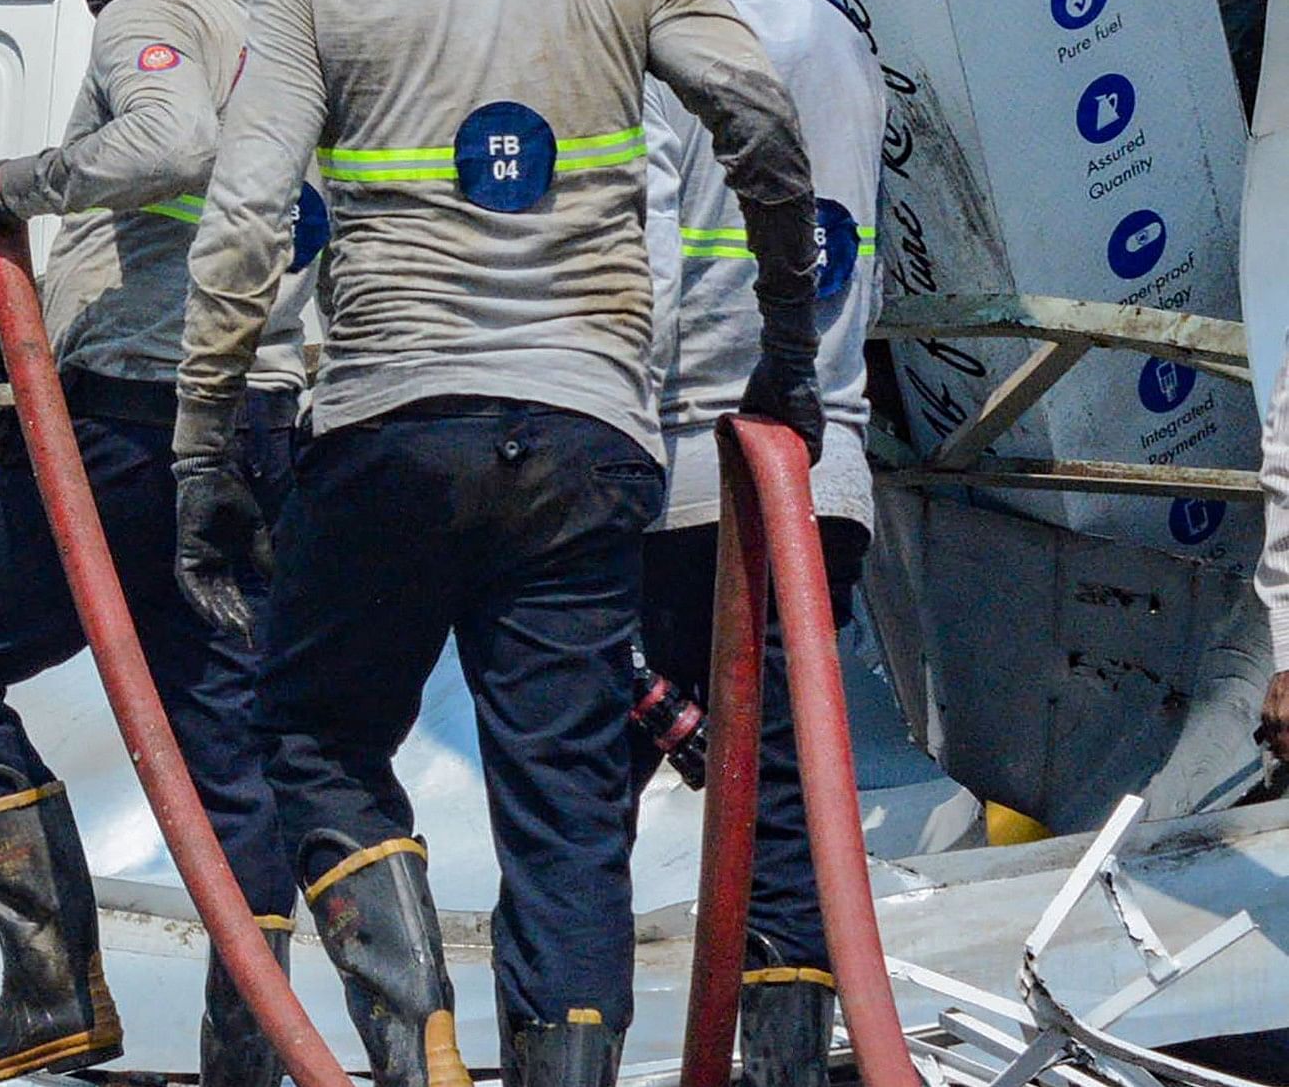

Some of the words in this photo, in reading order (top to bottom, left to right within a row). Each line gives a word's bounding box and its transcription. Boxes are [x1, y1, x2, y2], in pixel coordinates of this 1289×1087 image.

[1057, 38, 1092, 65] Pure
[1094, 15, 1124, 43] fuel
[488, 135, 520, 157] FB
[1087, 134, 1147, 177] Assured
[493, 160, 520, 182] 04
[1088, 157, 1154, 201] Quantity
[1140, 392, 1215, 450] Integrated
[1147, 421, 1218, 466] Payments
